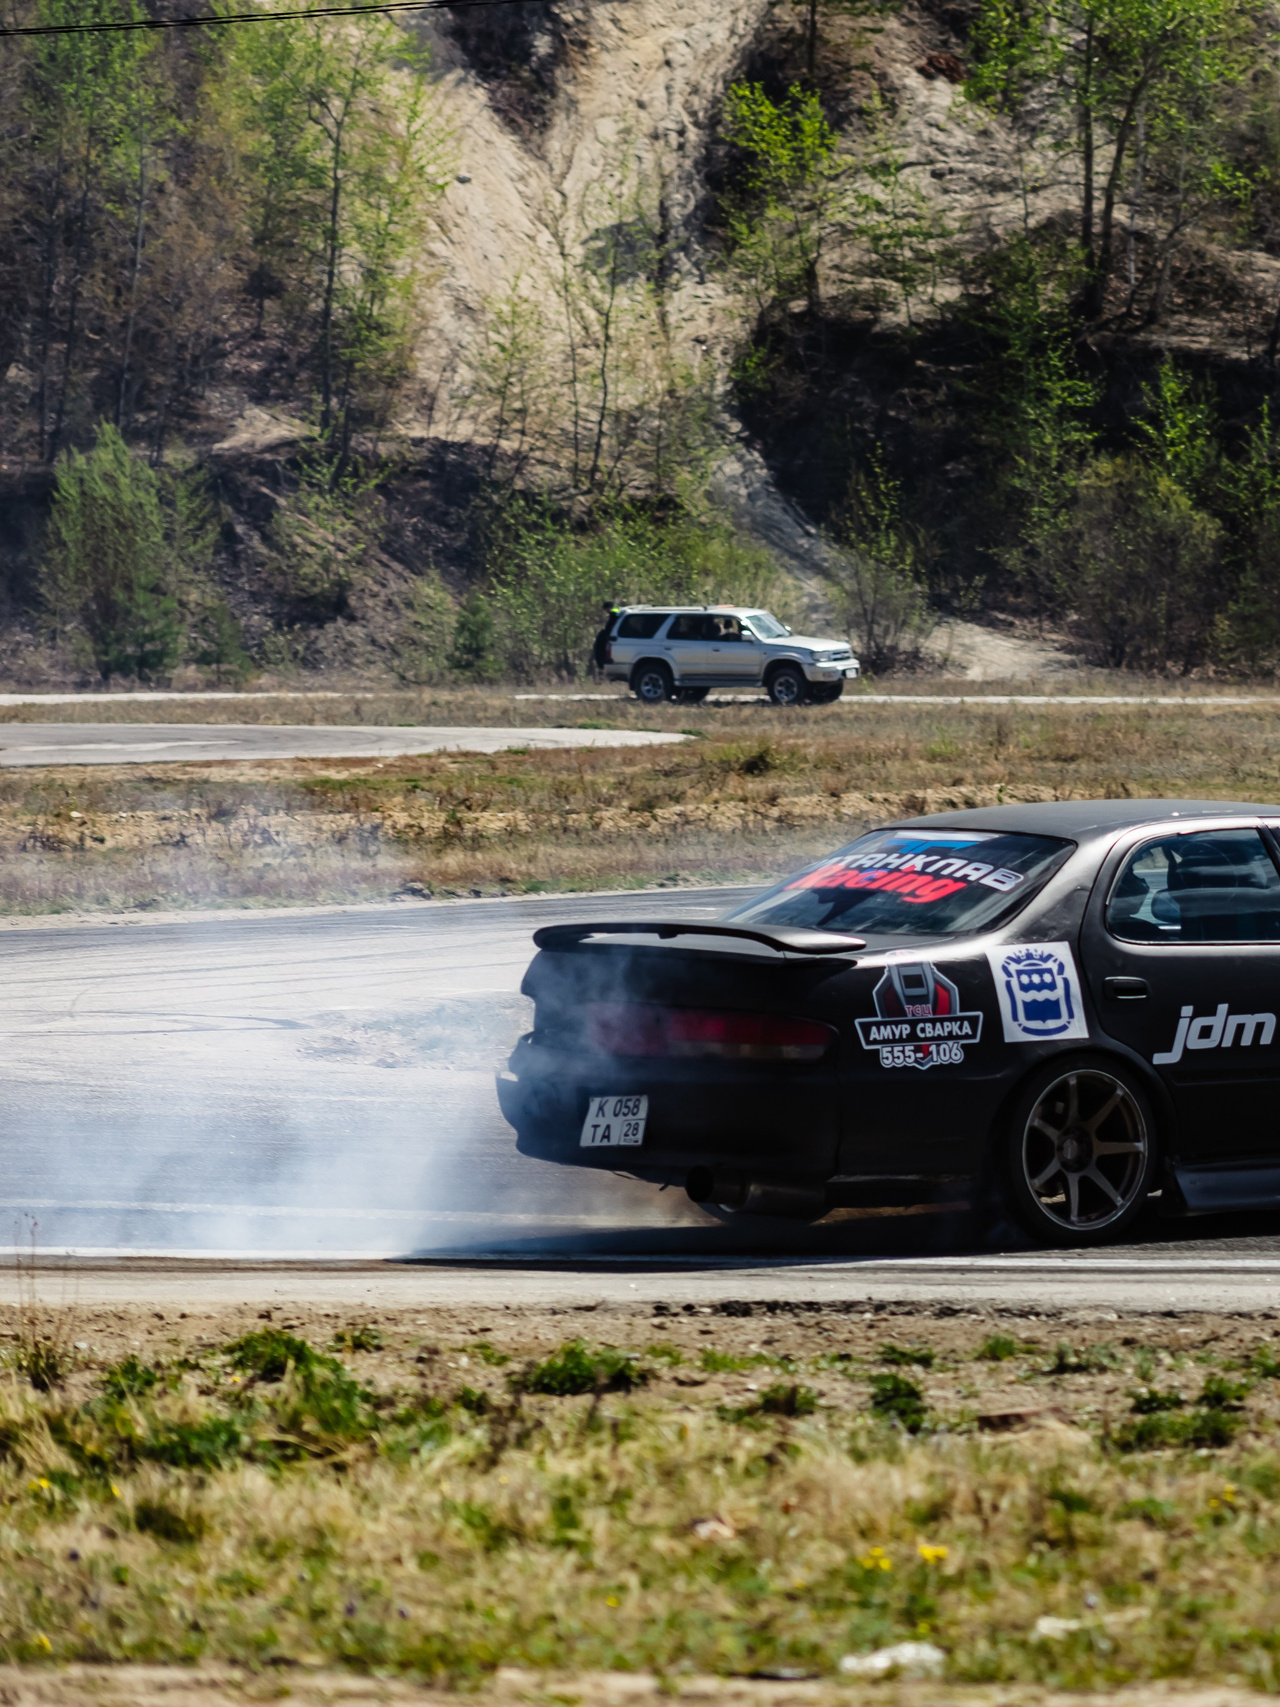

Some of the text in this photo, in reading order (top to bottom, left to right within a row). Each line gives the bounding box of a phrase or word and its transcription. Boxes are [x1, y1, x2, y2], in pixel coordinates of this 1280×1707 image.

[784, 863, 967, 904] Racing
[869, 1020, 972, 1041] АМУР СВАРКА
[1153, 1003, 1277, 1065] jdm
[612, 1098, 641, 1117] 058
[591, 1122, 640, 1143] ТА 28
